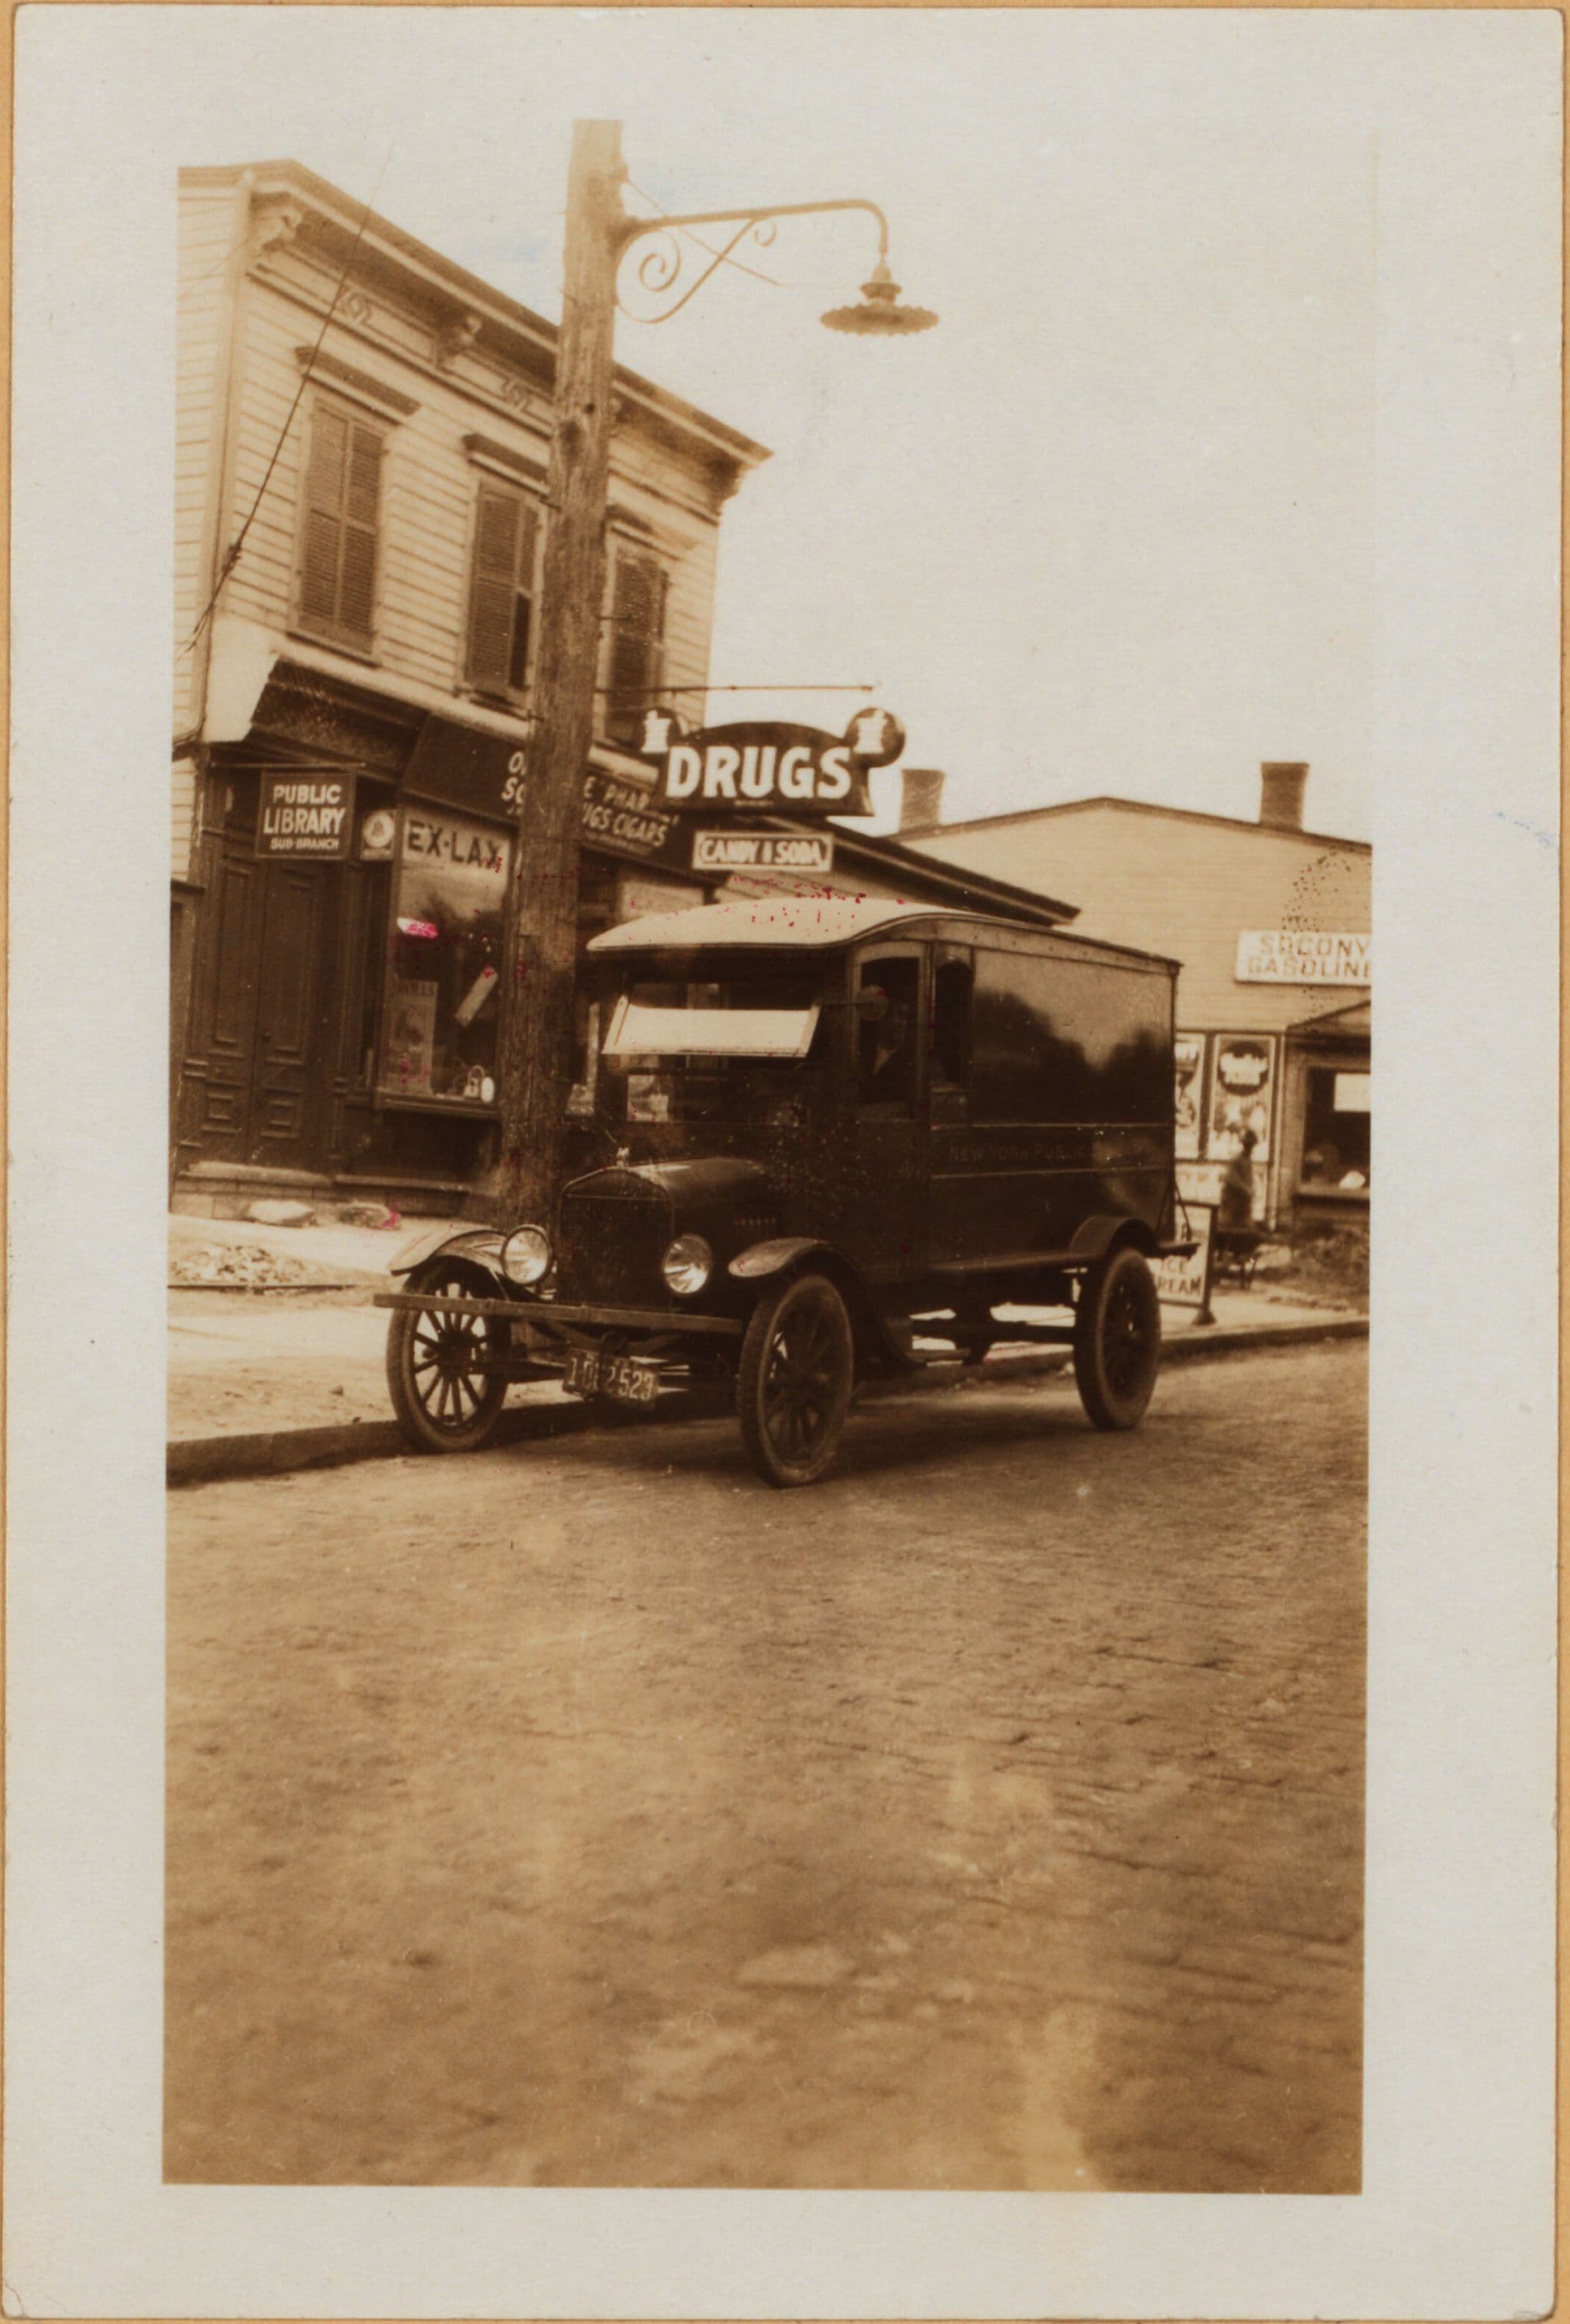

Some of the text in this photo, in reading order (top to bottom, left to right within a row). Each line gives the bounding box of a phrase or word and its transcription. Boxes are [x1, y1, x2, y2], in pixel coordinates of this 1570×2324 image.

[663, 746, 852, 799] DRUGS
[273, 784, 341, 804] PUBLIC
[262, 806, 348, 835] LIBRARY
[612, 814, 667, 847] CIGARS
[700, 840, 760, 863] CANDY
[774, 840, 820, 864] SODA
[1260, 934, 1369, 957] SOCONY
[1157, 1276, 1202, 1295] REAM
